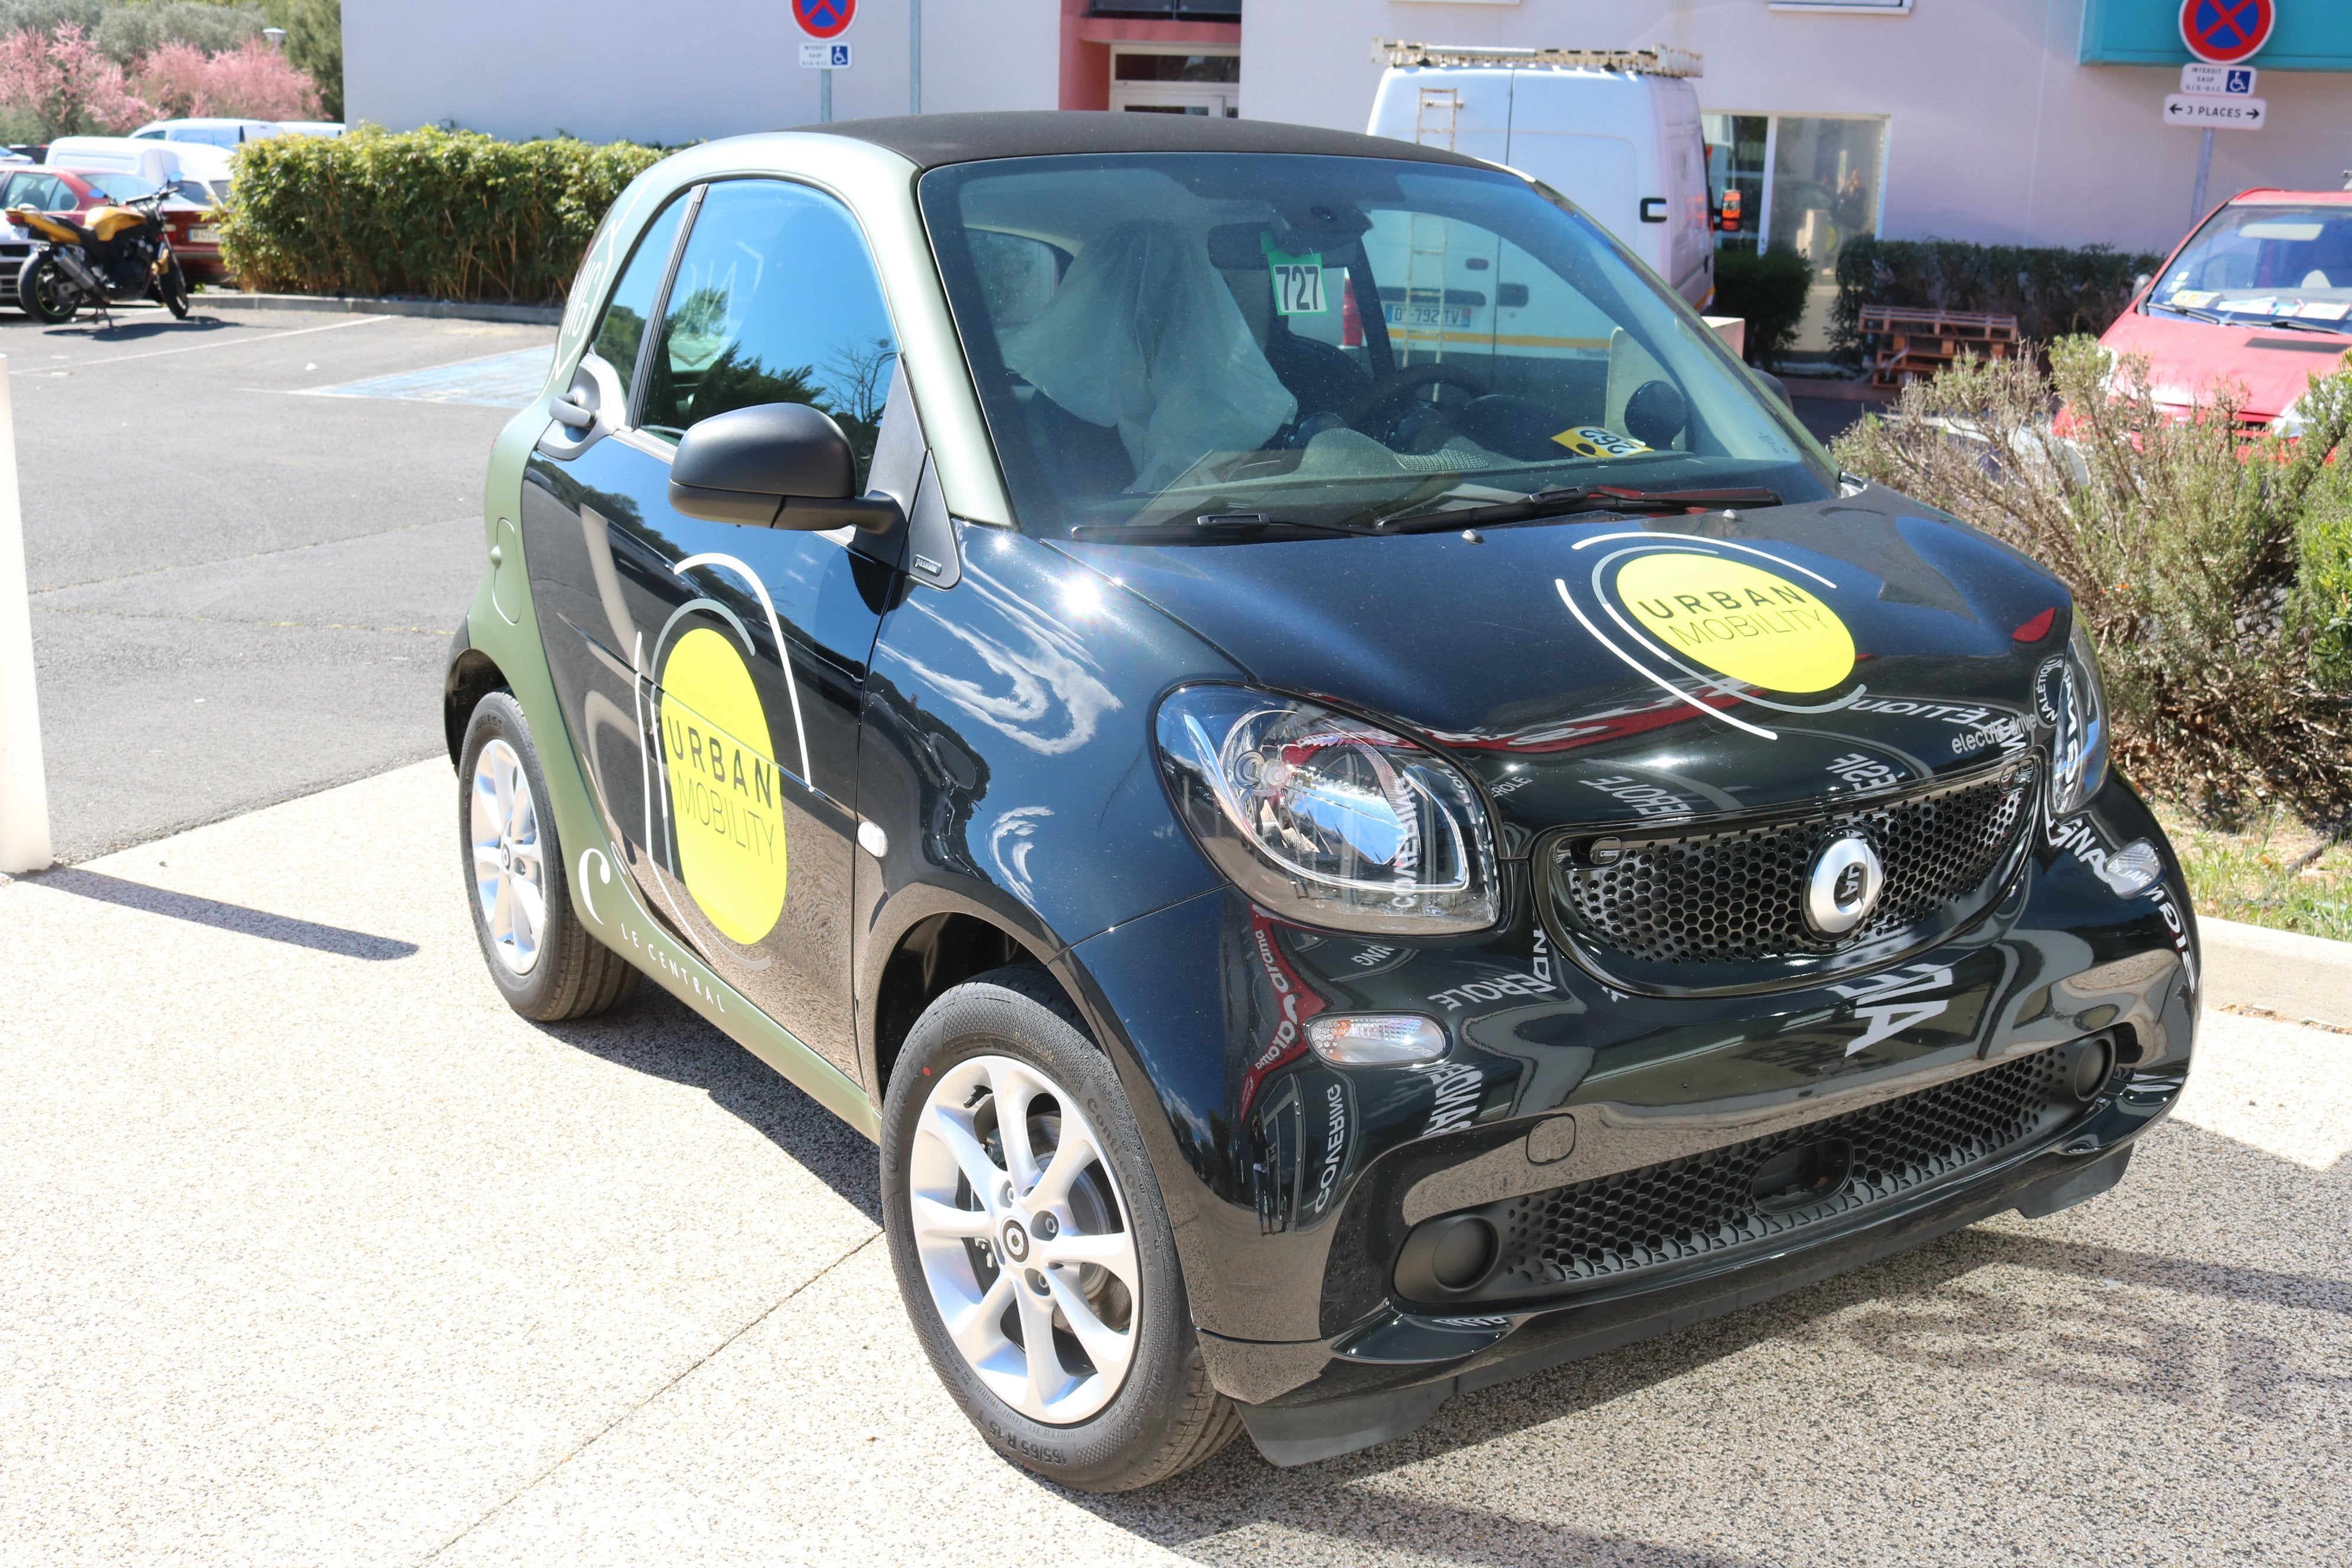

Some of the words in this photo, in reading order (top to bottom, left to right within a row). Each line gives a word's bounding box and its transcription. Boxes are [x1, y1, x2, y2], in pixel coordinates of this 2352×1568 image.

[2187, 106, 2193, 115] 3
[2198, 107, 2242, 117] PLACES
[1275, 265, 1319, 311] 727
[1579, 429, 1638, 454] 262
[914, 558, 937, 573] passion
[1637, 585, 1807, 619] URBAN
[1668, 609, 1829, 646] MOBILITY
[1951, 721, 2007, 754] electric
[2008, 713, 2037, 736] drive
[667, 715, 773, 809] URBAN
[676, 769, 775, 865] MOBILITY
[621, 923, 639, 948] LE
[648, 943, 726, 1013] CENTRAL
[988, 1422, 1006, 1442] 15
[1005, 1430, 1019, 1451] R
[1020, 1438, 1069, 1466] 165/65
